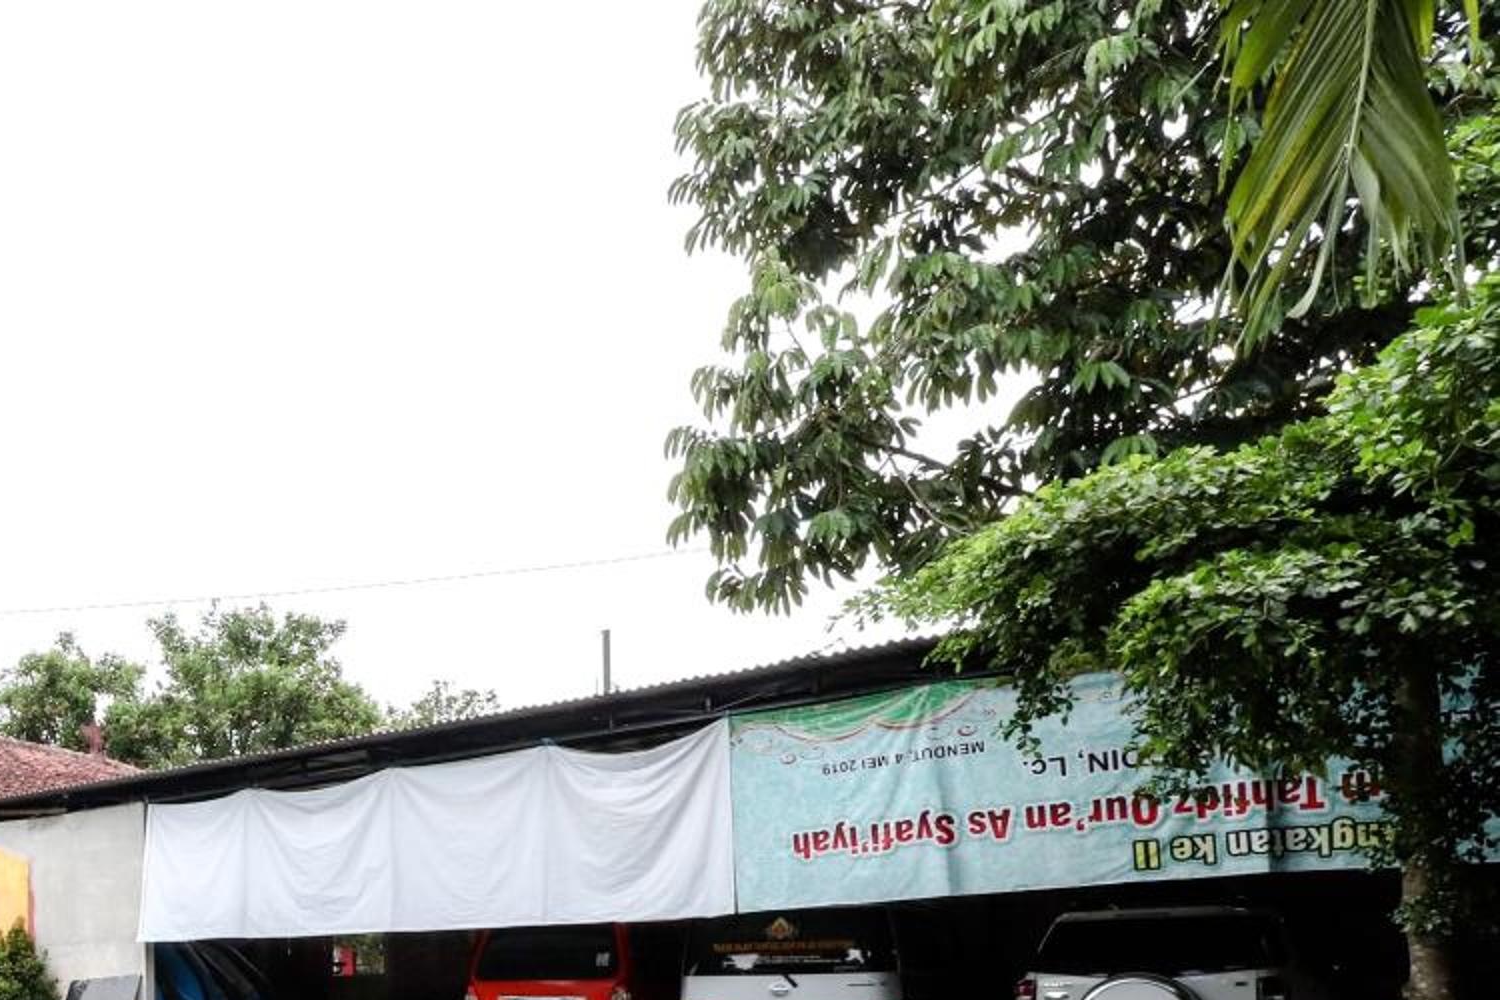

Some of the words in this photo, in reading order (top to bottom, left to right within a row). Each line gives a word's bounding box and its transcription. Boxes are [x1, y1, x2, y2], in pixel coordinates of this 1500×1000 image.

[822, 760, 857, 776] 2019
[860, 755, 888, 770] MEI
[894, 753, 904, 764] 4
[1025, 789, 1160, 832] Qur'an
[1172, 773, 1325, 818] Tahfidz
[793, 810, 955, 859] Syafi'iyah
[969, 808, 1011, 840] As
[1133, 838, 1162, 871] II
[1170, 833, 1217, 865] ke
